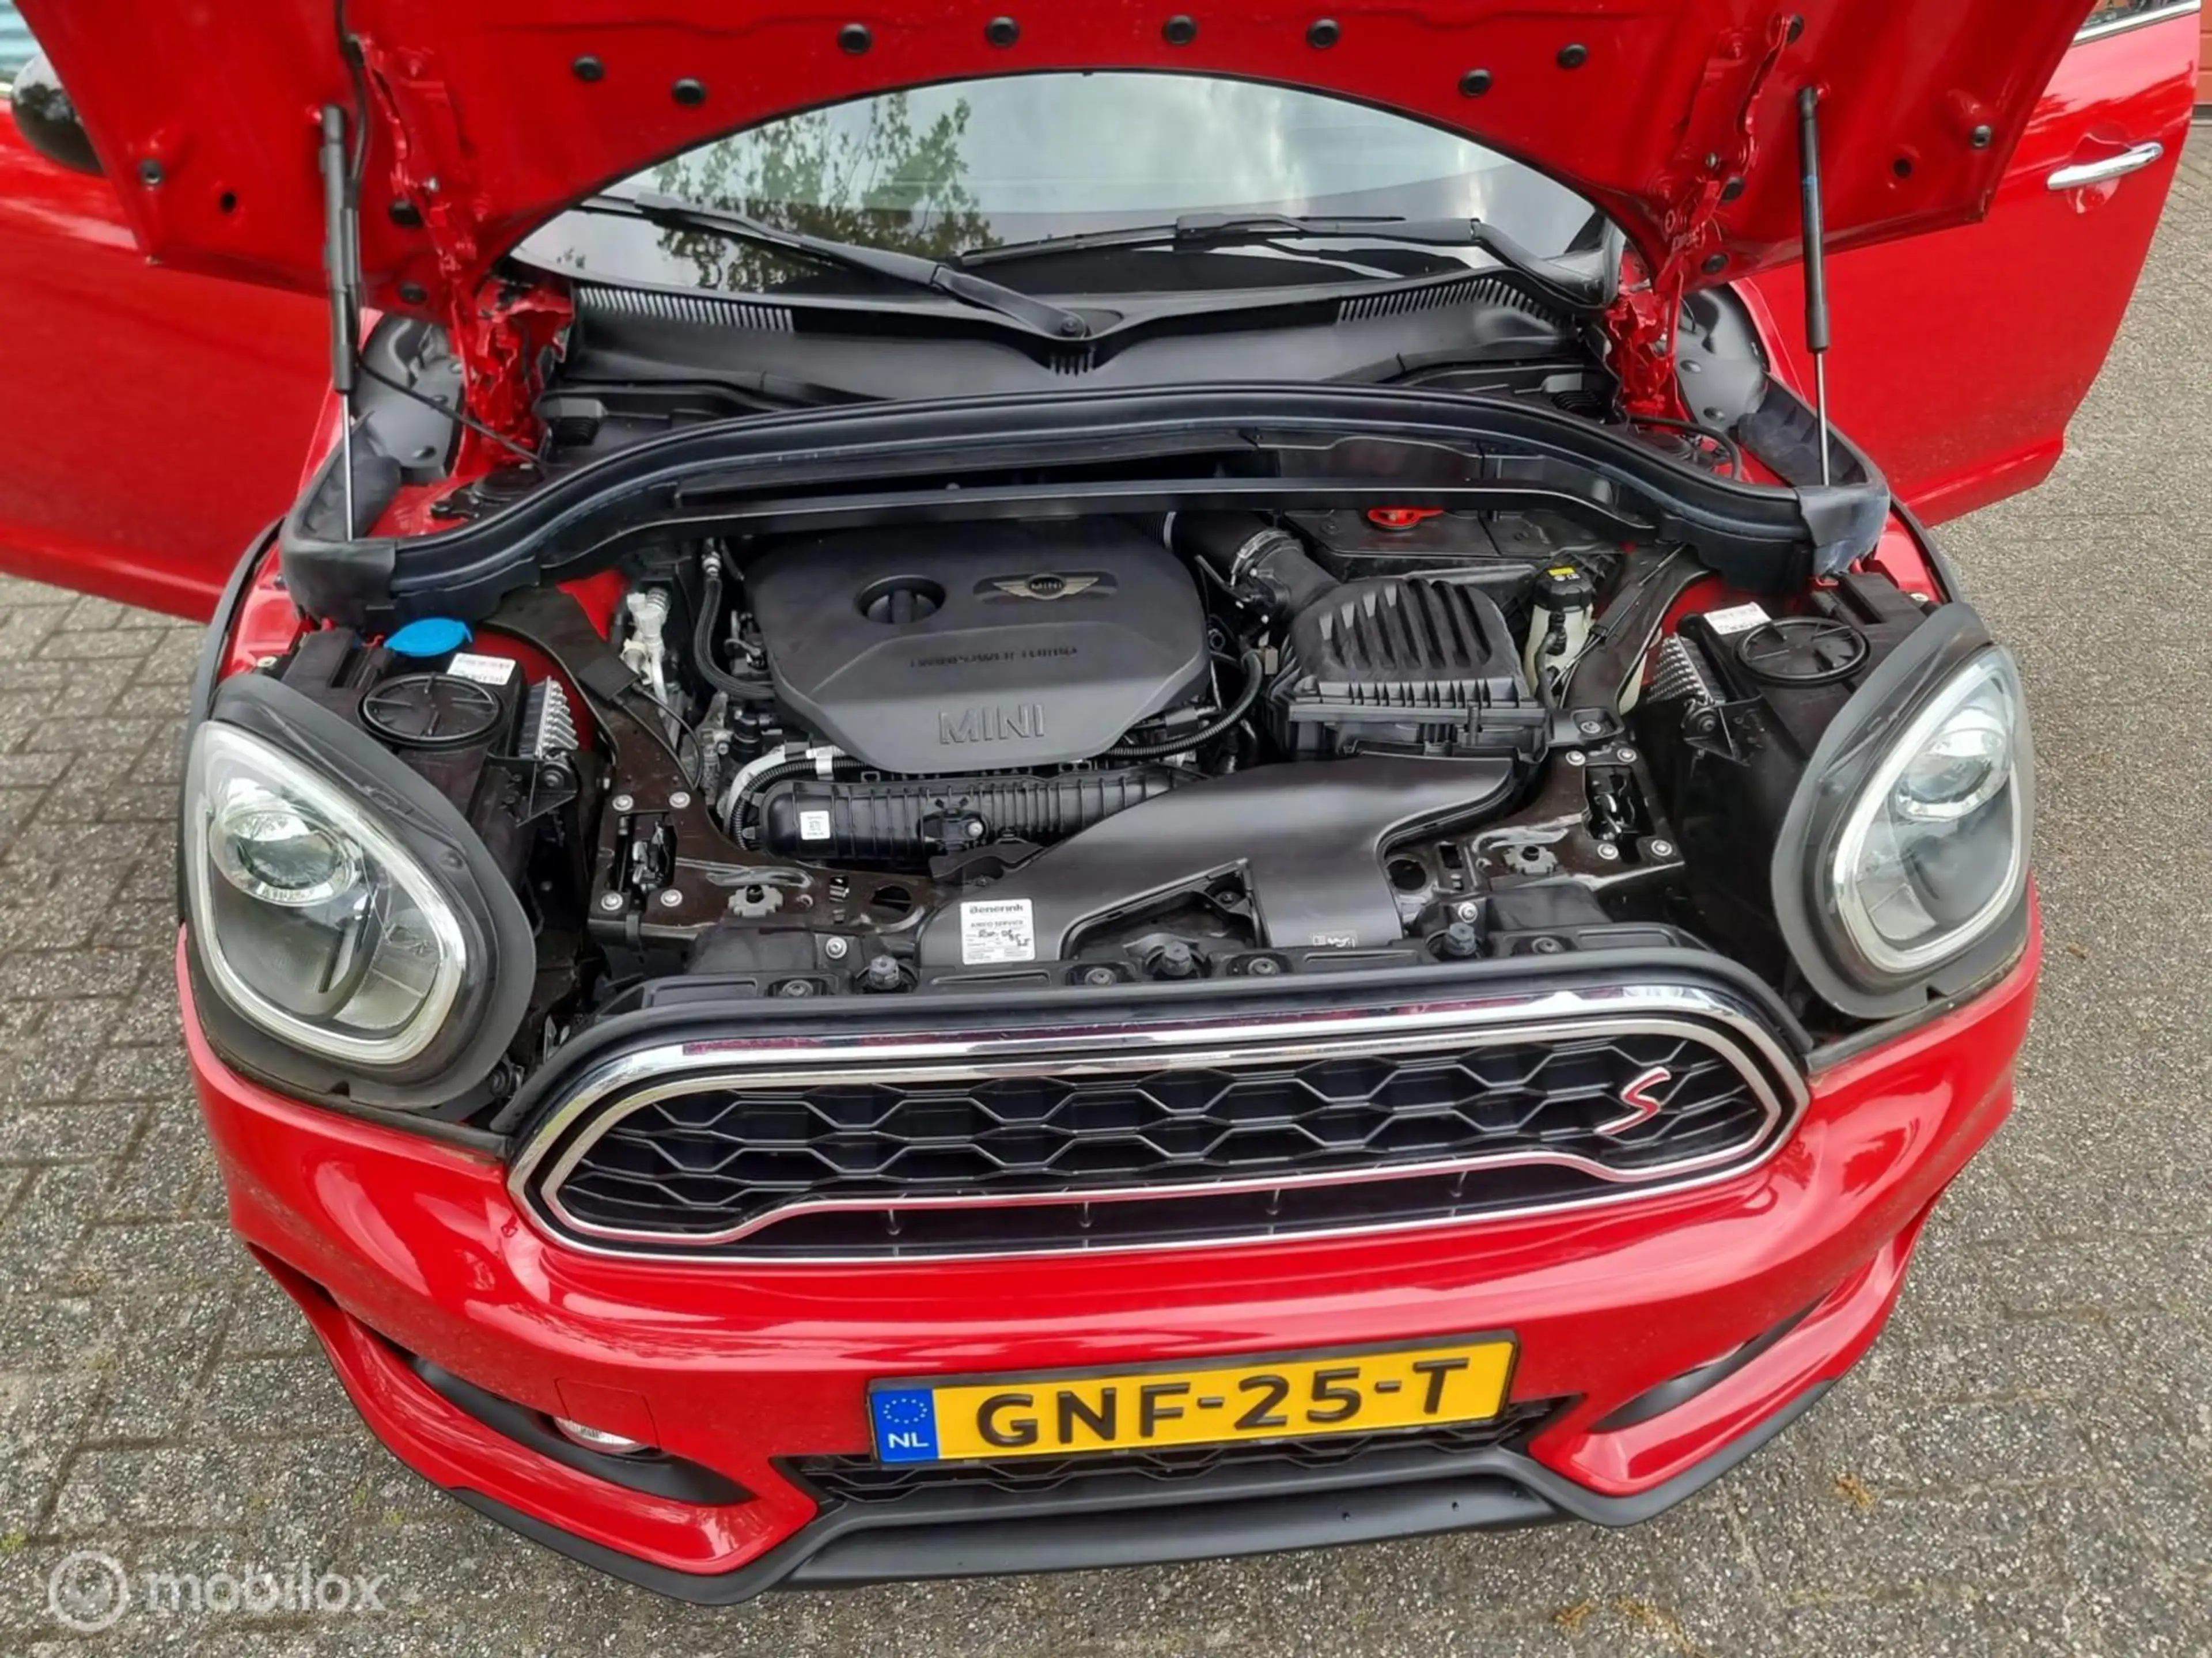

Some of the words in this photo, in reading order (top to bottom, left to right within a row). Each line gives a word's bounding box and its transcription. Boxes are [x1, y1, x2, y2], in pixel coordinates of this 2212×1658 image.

[1031, 582, 1062, 590] MINI
[938, 704, 1045, 745] MINI
[1593, 1067, 1671, 1135] S
[976, 1357, 1469, 1448] GNF-25-T
[888, 1432, 929, 1449] NL
